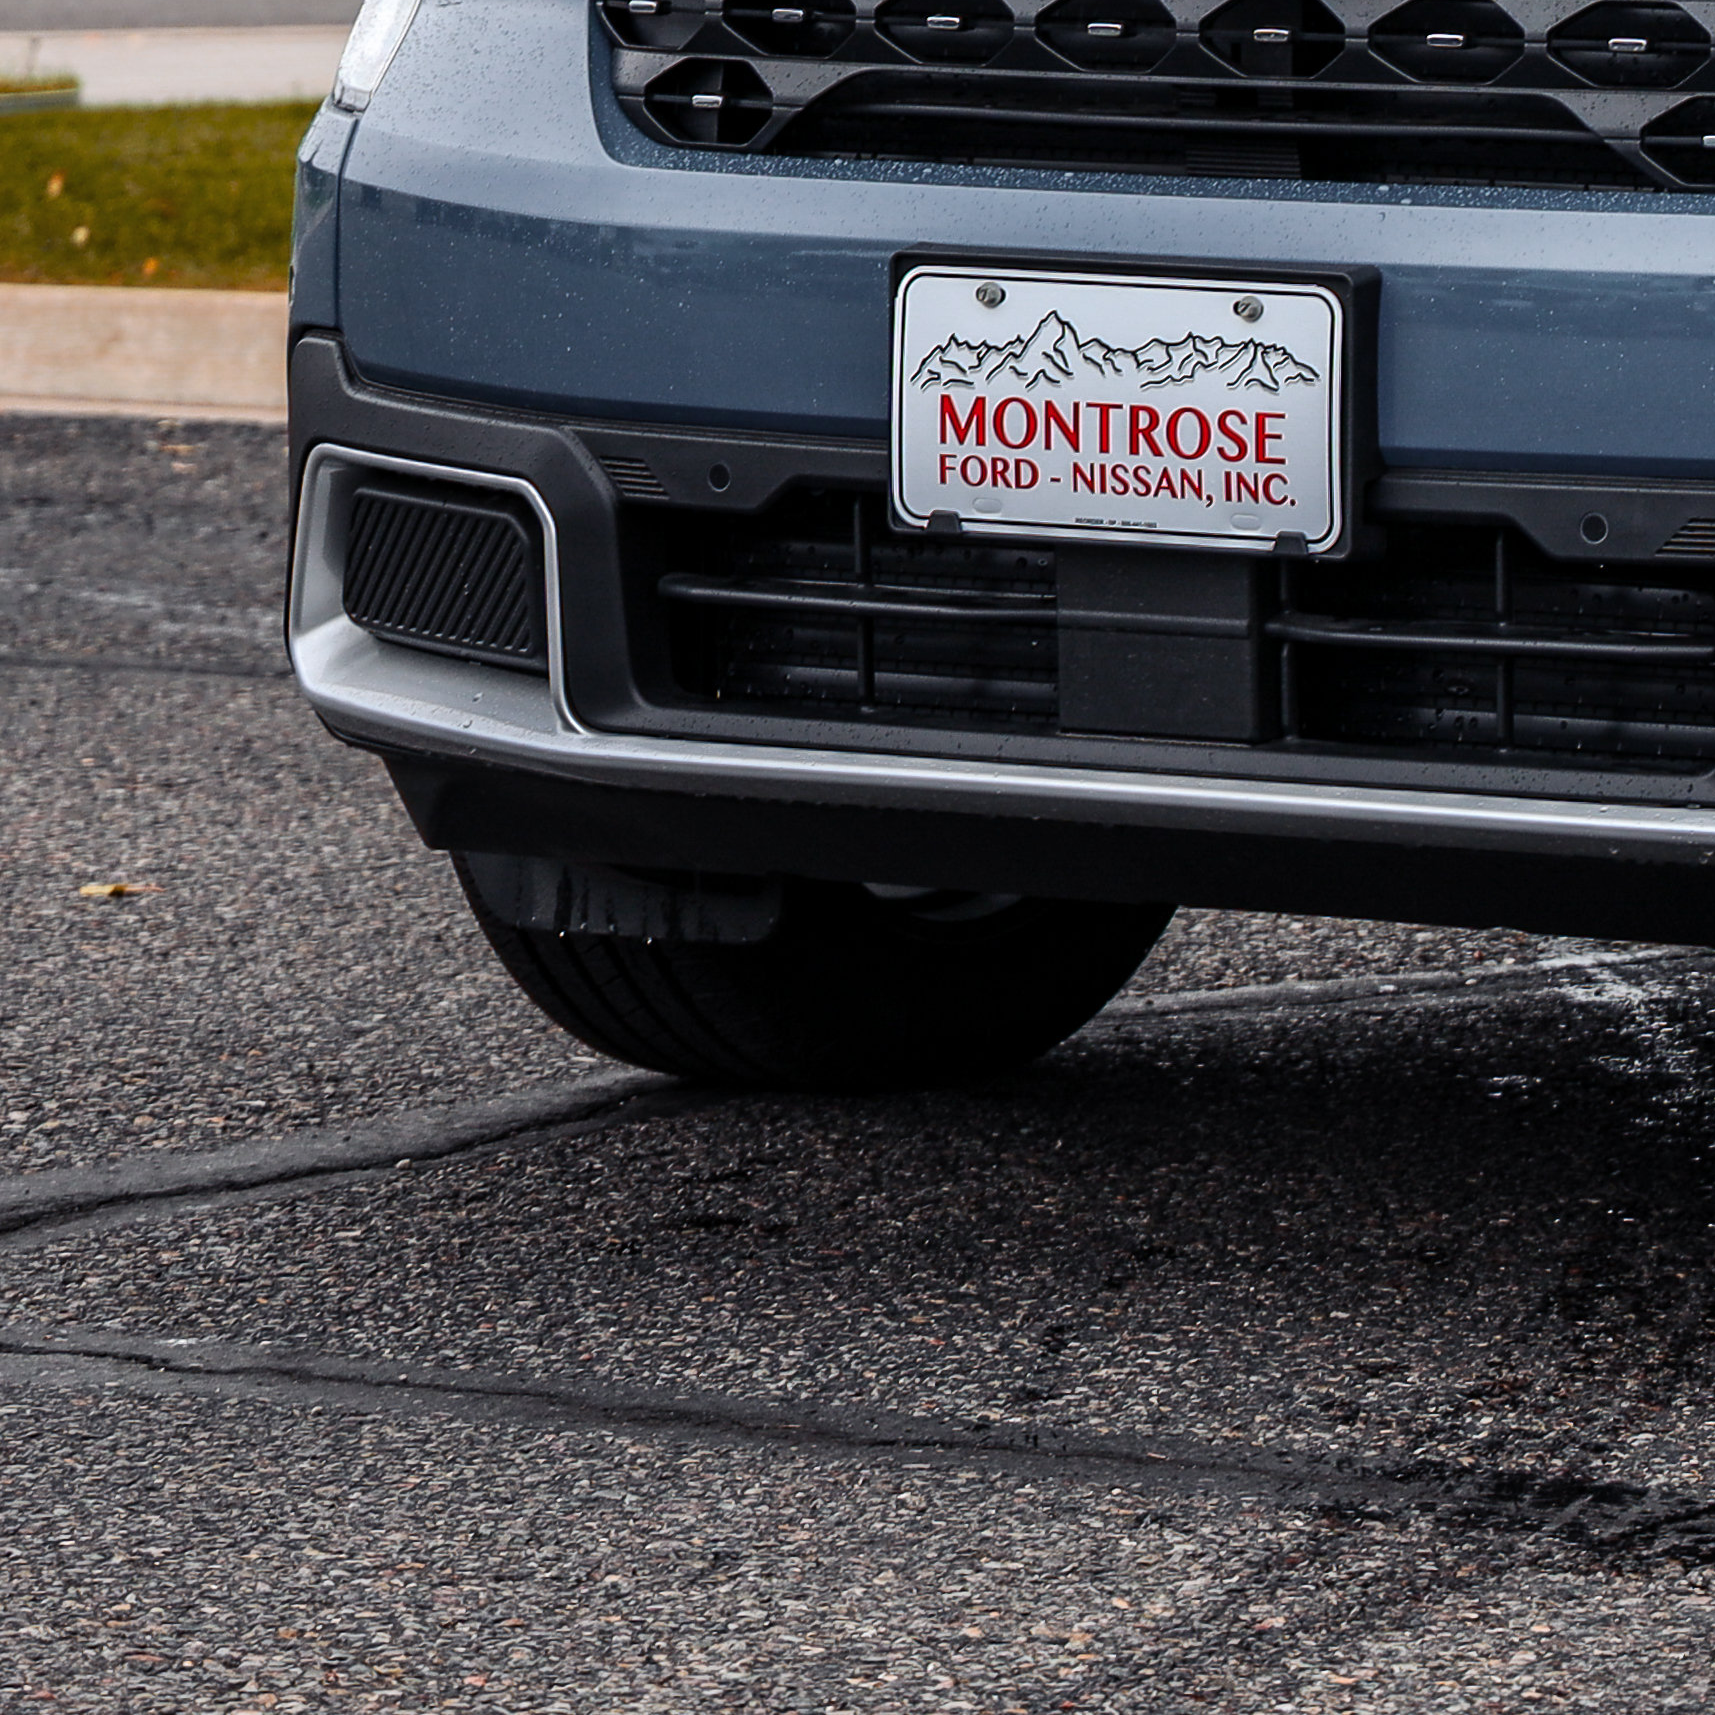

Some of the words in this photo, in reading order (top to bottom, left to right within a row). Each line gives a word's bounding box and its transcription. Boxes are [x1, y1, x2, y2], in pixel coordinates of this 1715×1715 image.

[938, 394, 1288, 466] MONTROSE
[938, 453, 1040, 490] FORD
[1073, 462, 1214, 509] NISSAN,
[1224, 472, 1298, 508] INC.
